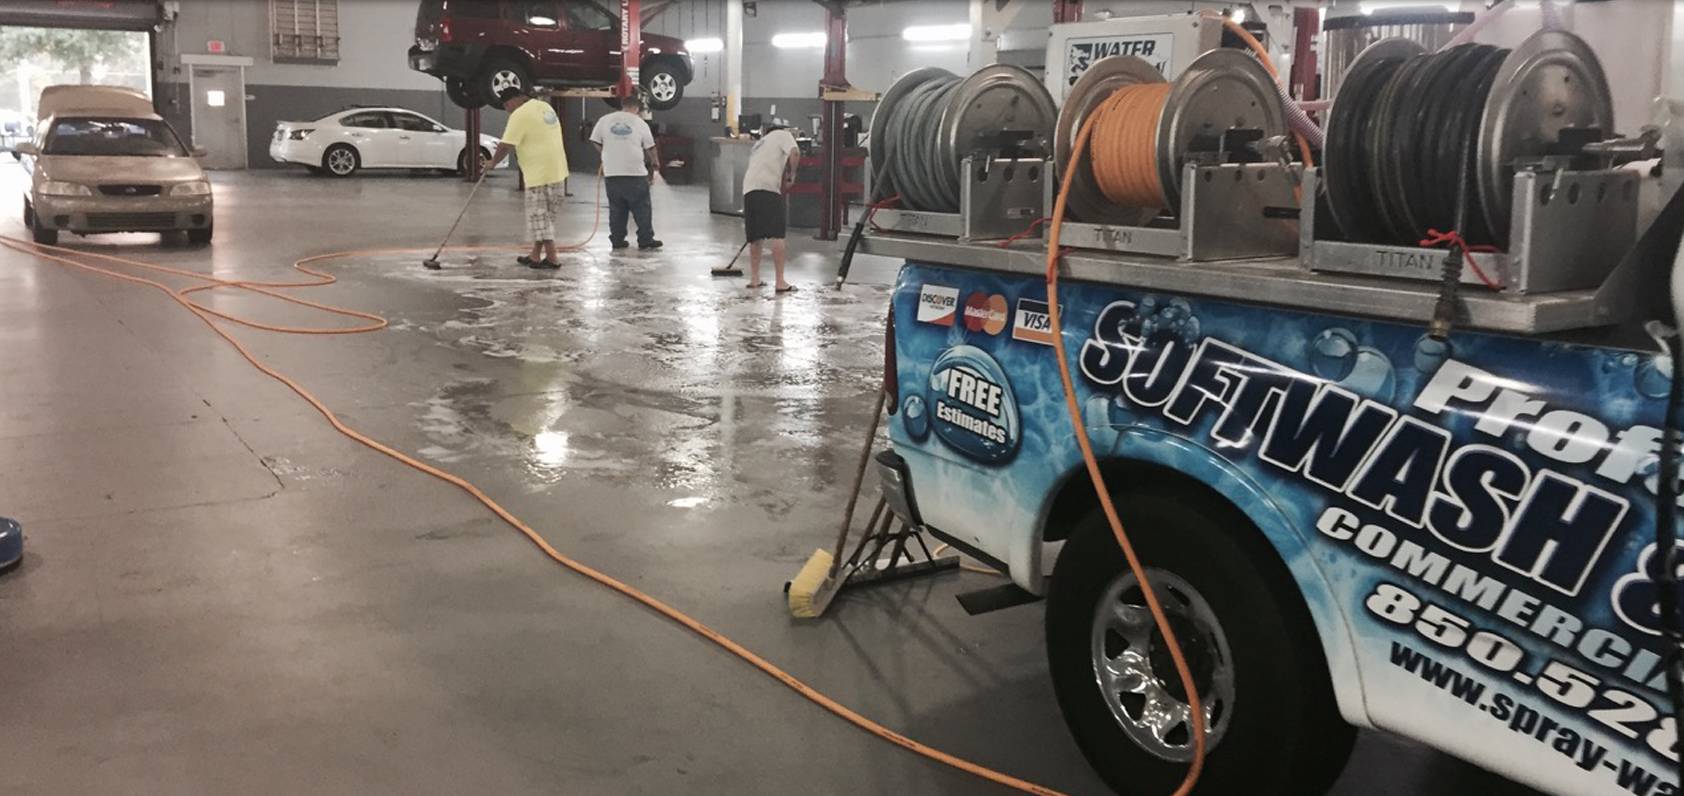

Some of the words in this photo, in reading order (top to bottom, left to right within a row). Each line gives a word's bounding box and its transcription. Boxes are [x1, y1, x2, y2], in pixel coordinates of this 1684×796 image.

[621, 8, 629, 45] ROTARY
[1376, 250, 1434, 269] TITAN
[922, 293, 955, 307] DISCOVER
[949, 367, 1003, 417] FREE
[936, 401, 1007, 444] Estimates
[1080, 301, 1630, 597] SOFTWASH
